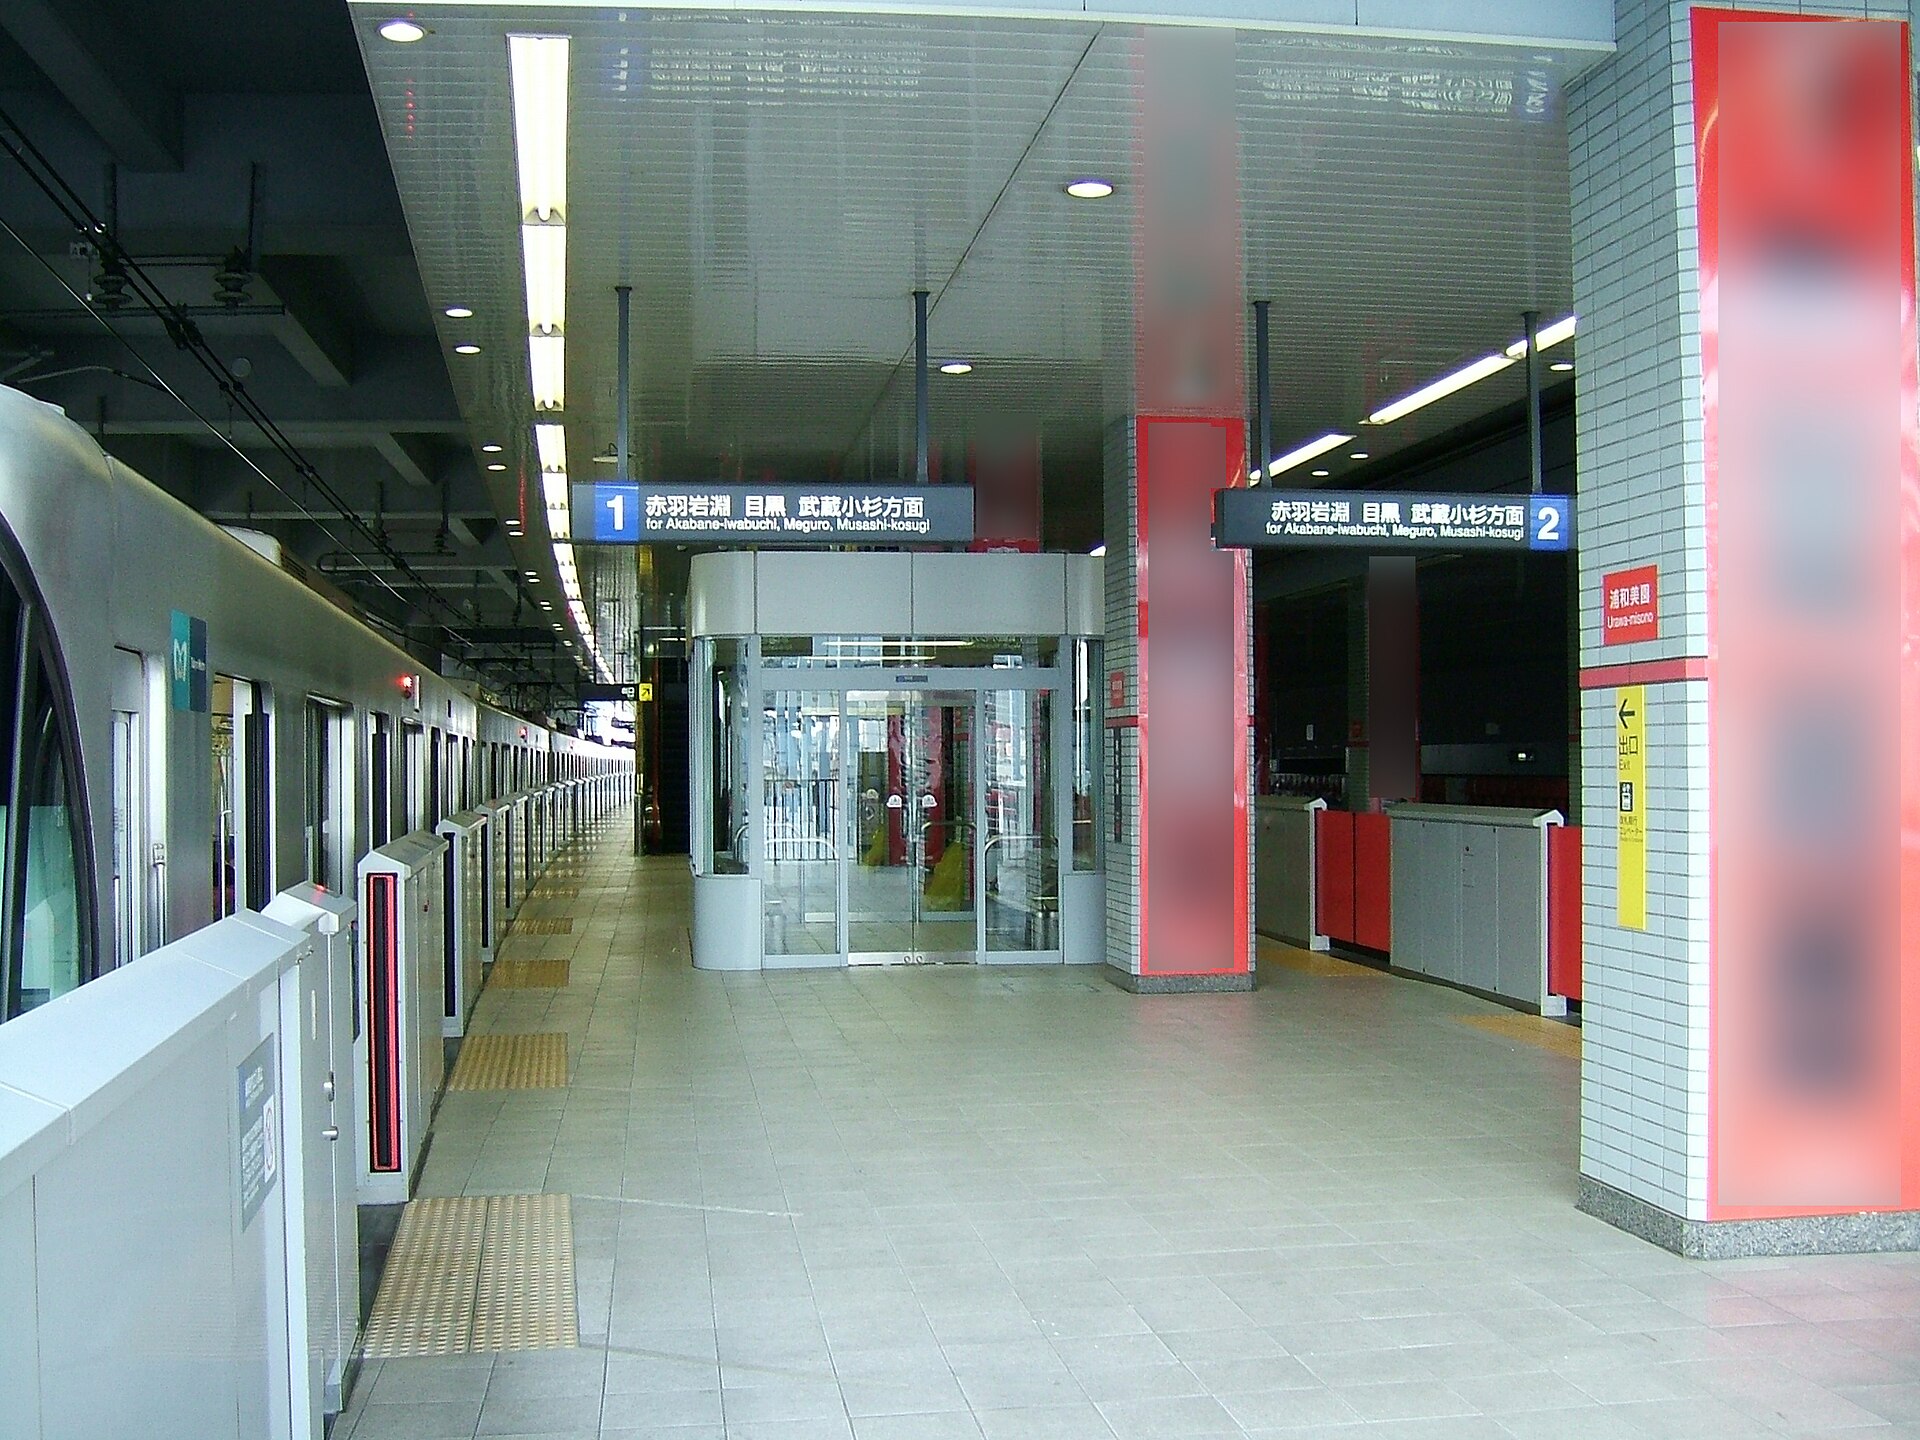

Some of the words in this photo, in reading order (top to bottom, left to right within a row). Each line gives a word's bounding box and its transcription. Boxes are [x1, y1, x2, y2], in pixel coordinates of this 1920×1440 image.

[606, 494, 624, 531] 1
[645, 495, 731, 518] 赤羽岩淵
[745, 495, 786, 517] 目黒
[798, 495, 924, 518] 武蔵小杉方面
[1271, 500, 1350, 523] 赤羽岩淵
[1362, 502, 1400, 524] 目黒
[1410, 503, 1524, 526] 武蔵小杉方面
[645, 518, 662, 530] for
[783, 518, 834, 533] Meguro,
[837, 518, 930, 534] Musashi-kosugi
[1265, 522, 1281, 534] for
[1392, 524, 1437, 539] Meguro,
[1440, 525, 1524, 541] Musashi-kosugi
[1537, 506, 1560, 540] 2
[1609, 583, 1650, 609] 浦和美園
[1607, 611, 1654, 629] Urawa-misono
[1618, 735, 1639, 755] 出口
[1618, 759, 1630, 770] Exit
